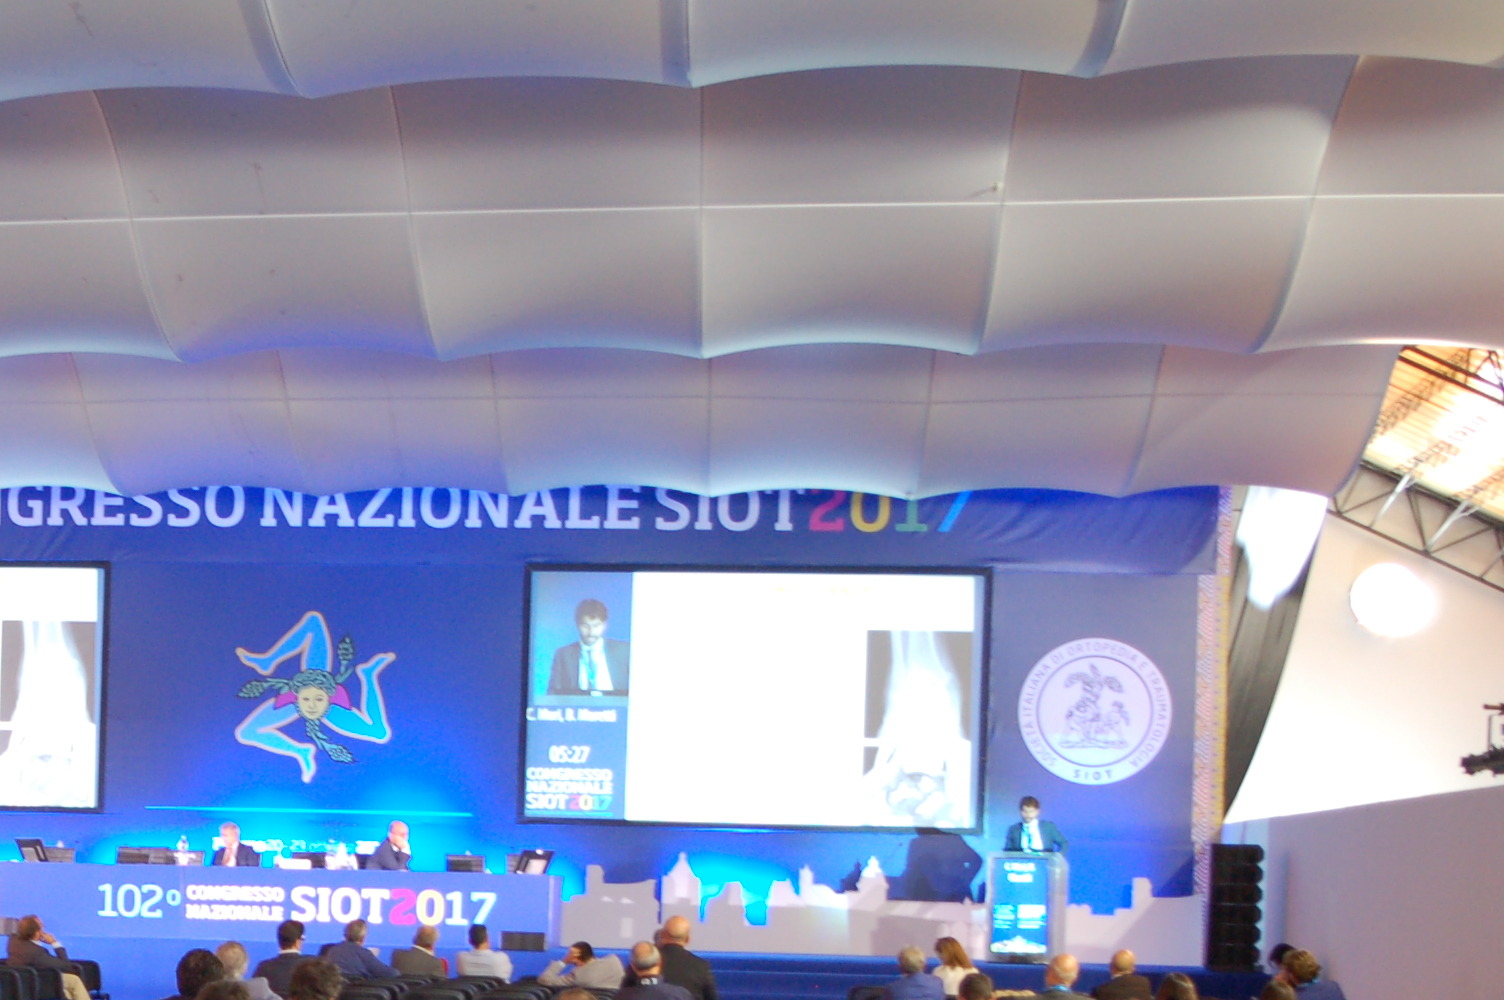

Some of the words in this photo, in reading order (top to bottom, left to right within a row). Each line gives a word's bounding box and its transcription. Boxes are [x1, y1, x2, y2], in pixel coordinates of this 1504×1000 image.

[259, 485, 641, 529] NAZIONALE
[526, 767, 614, 781] CONGRESSO
[526, 780, 614, 794] NAZIONALE
[185, 885, 285, 902] CONGRESSO
[185, 904, 284, 921] NAZIONALE
